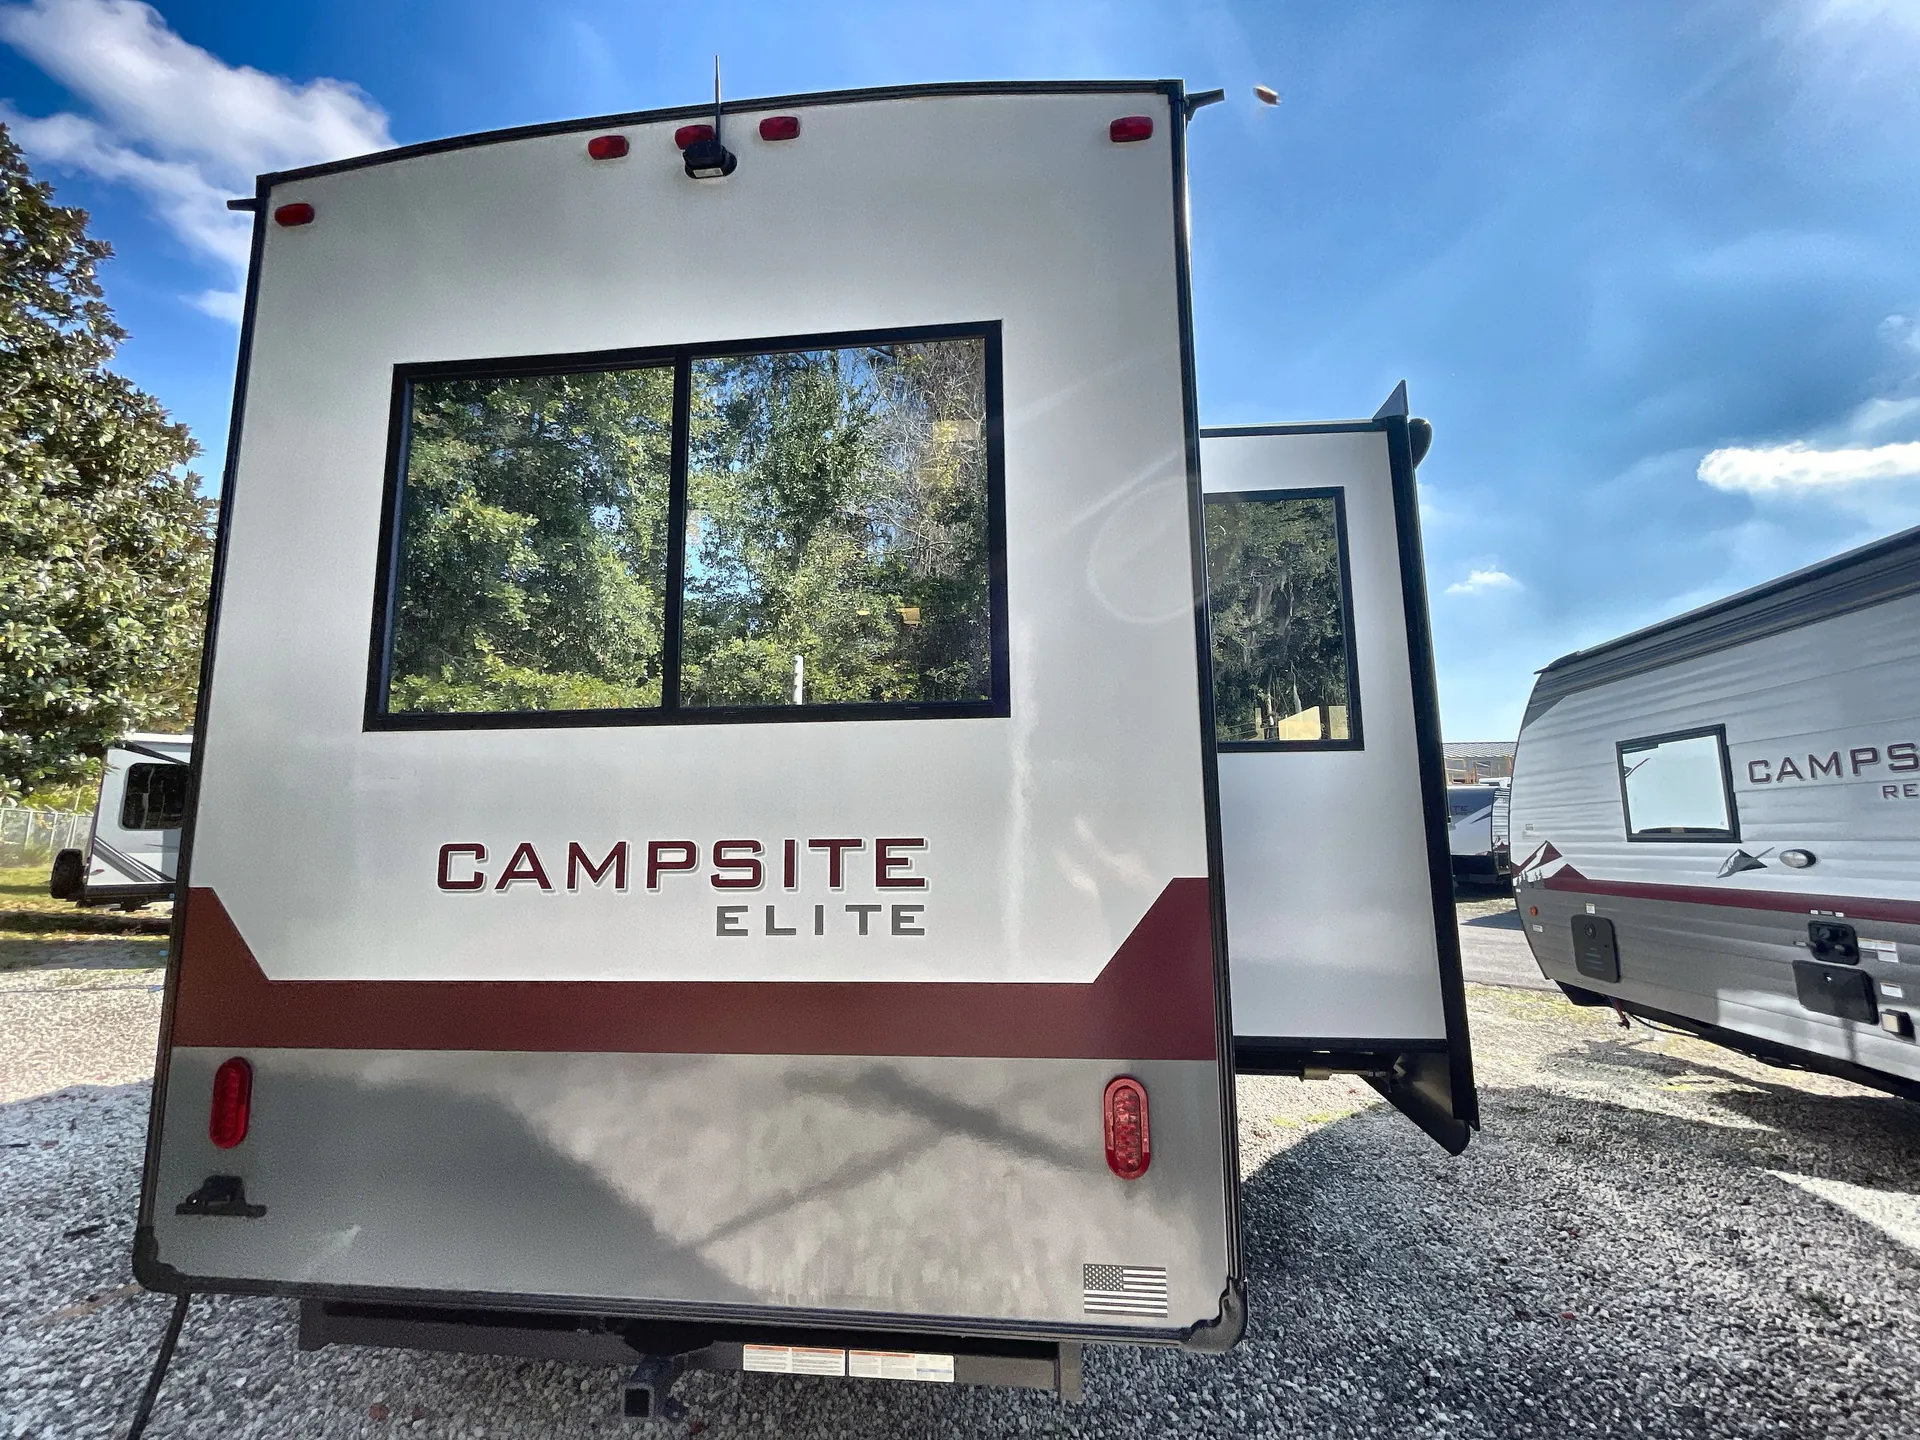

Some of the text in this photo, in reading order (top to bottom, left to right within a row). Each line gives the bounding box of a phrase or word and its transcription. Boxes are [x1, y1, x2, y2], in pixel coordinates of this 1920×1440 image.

[1748, 742, 1919, 784] CAMPS
[436, 837, 929, 893] CAMPSITE
[716, 904, 925, 937] ELITE
